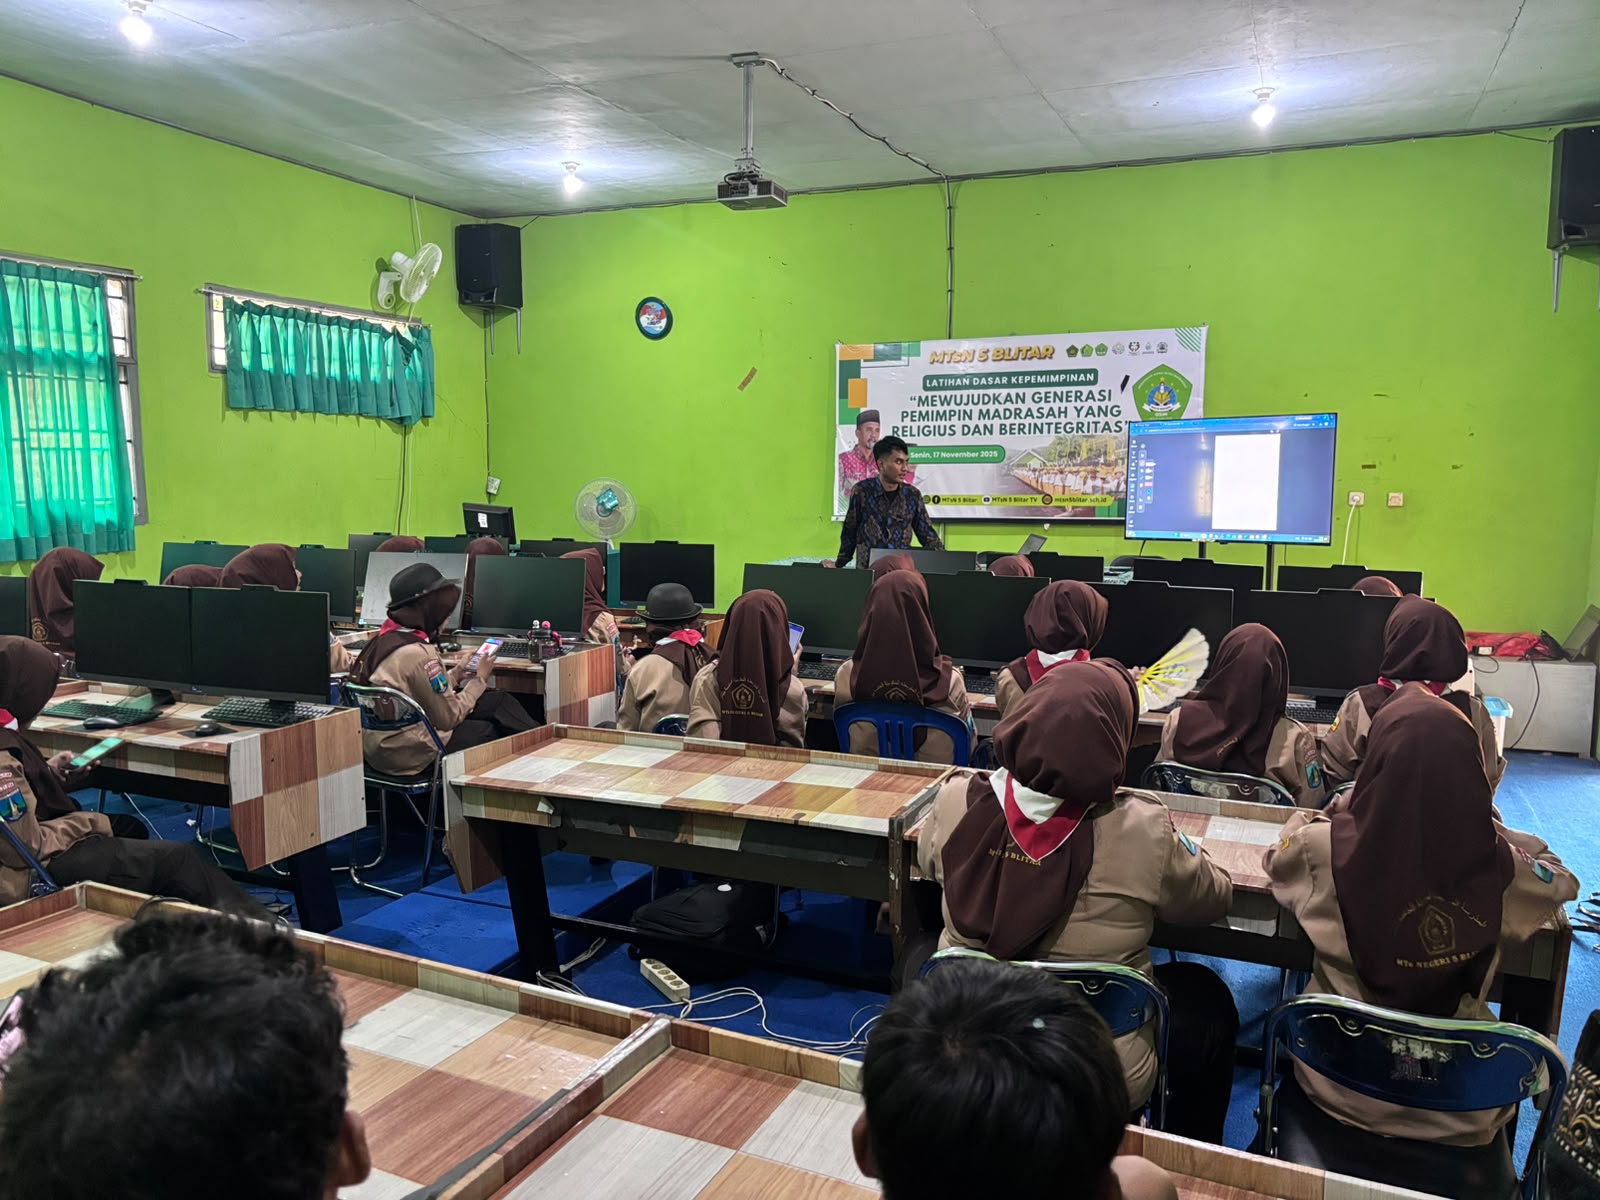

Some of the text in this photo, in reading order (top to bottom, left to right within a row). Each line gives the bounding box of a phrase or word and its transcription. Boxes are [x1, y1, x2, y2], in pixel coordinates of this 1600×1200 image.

[929, 344, 1055, 364] MTsN 5 BLITAR
[926, 373, 1095, 388] LATIHAN DASAR KEPEMIMPINAN
[910, 389, 1112, 407] “MEWUJUDKAN GENERASI
[901, 405, 1122, 422] PEMIMPIN MADRASAH YANG
[892, 425, 956, 438] RELIGIUS
[961, 423, 994, 436] DAN
[910, 451, 932, 459] Senin,
[941, 450, 979, 459] November
[980, 450, 998, 458] 2025
